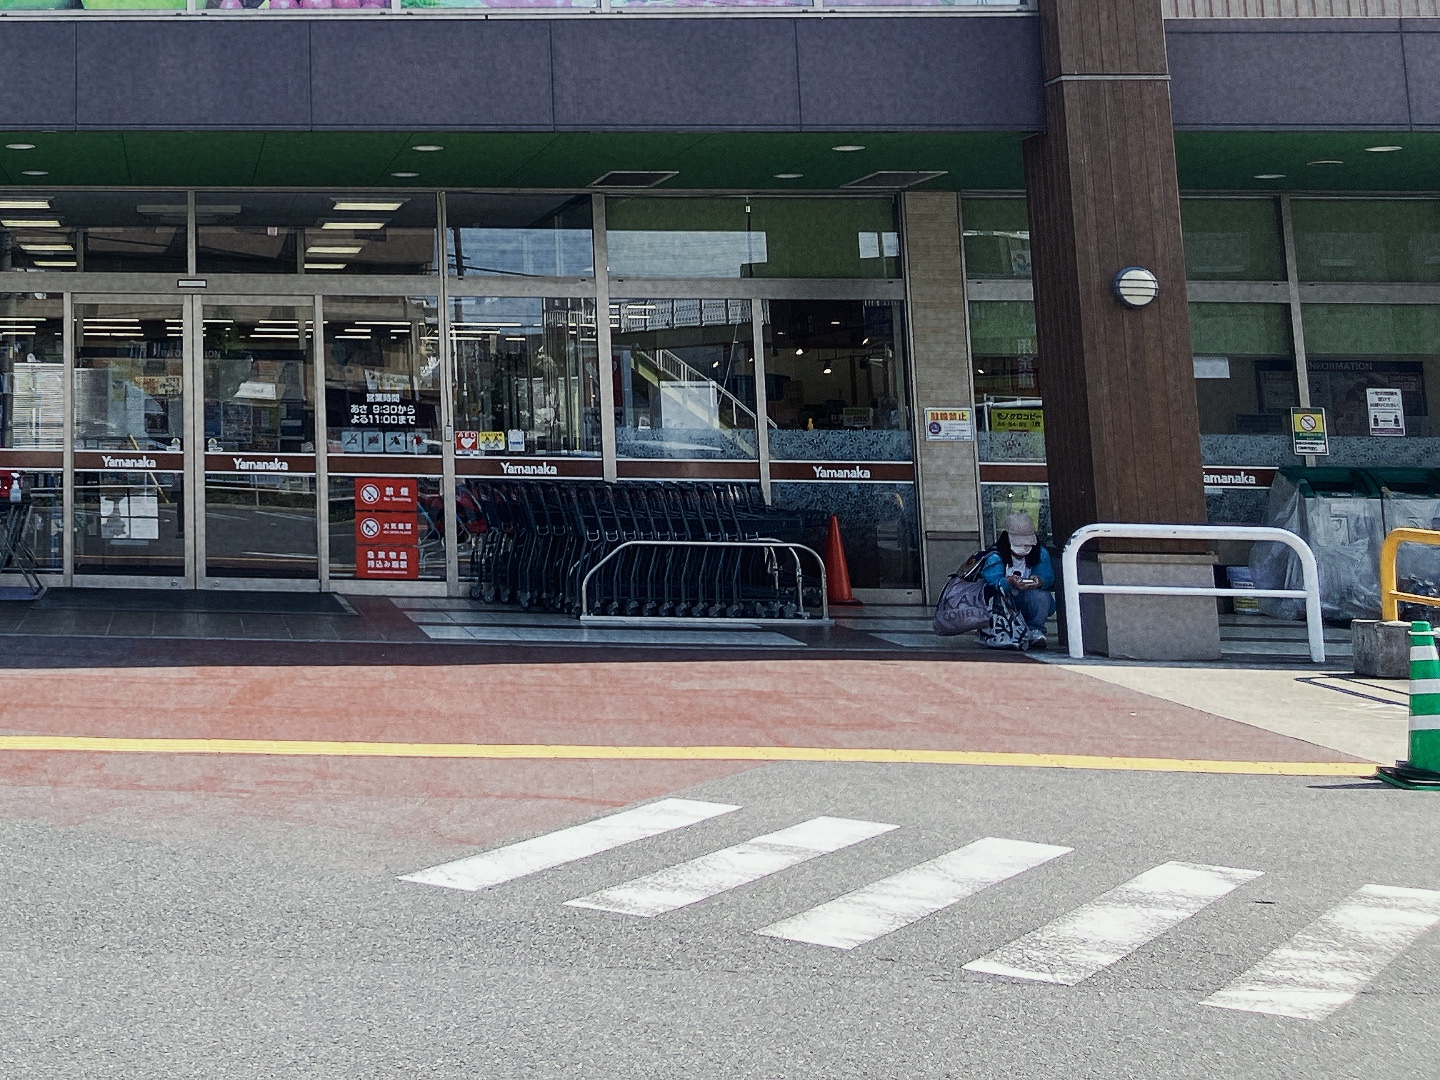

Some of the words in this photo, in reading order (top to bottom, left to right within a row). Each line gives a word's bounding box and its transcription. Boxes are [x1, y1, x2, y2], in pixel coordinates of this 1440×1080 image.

[1308, 362, 1373, 371] NFORMATION
[351, 404, 367, 414] あさ
[350, 415, 416, 424] よる11:00まで
[102, 455, 157, 468] Yamanaka
[233, 458, 288, 470] Yamanaka
[500, 461, 557, 474] Yamanaka
[812, 465, 871, 478] Yamanaka
[1203, 471, 1256, 484] amanaka
